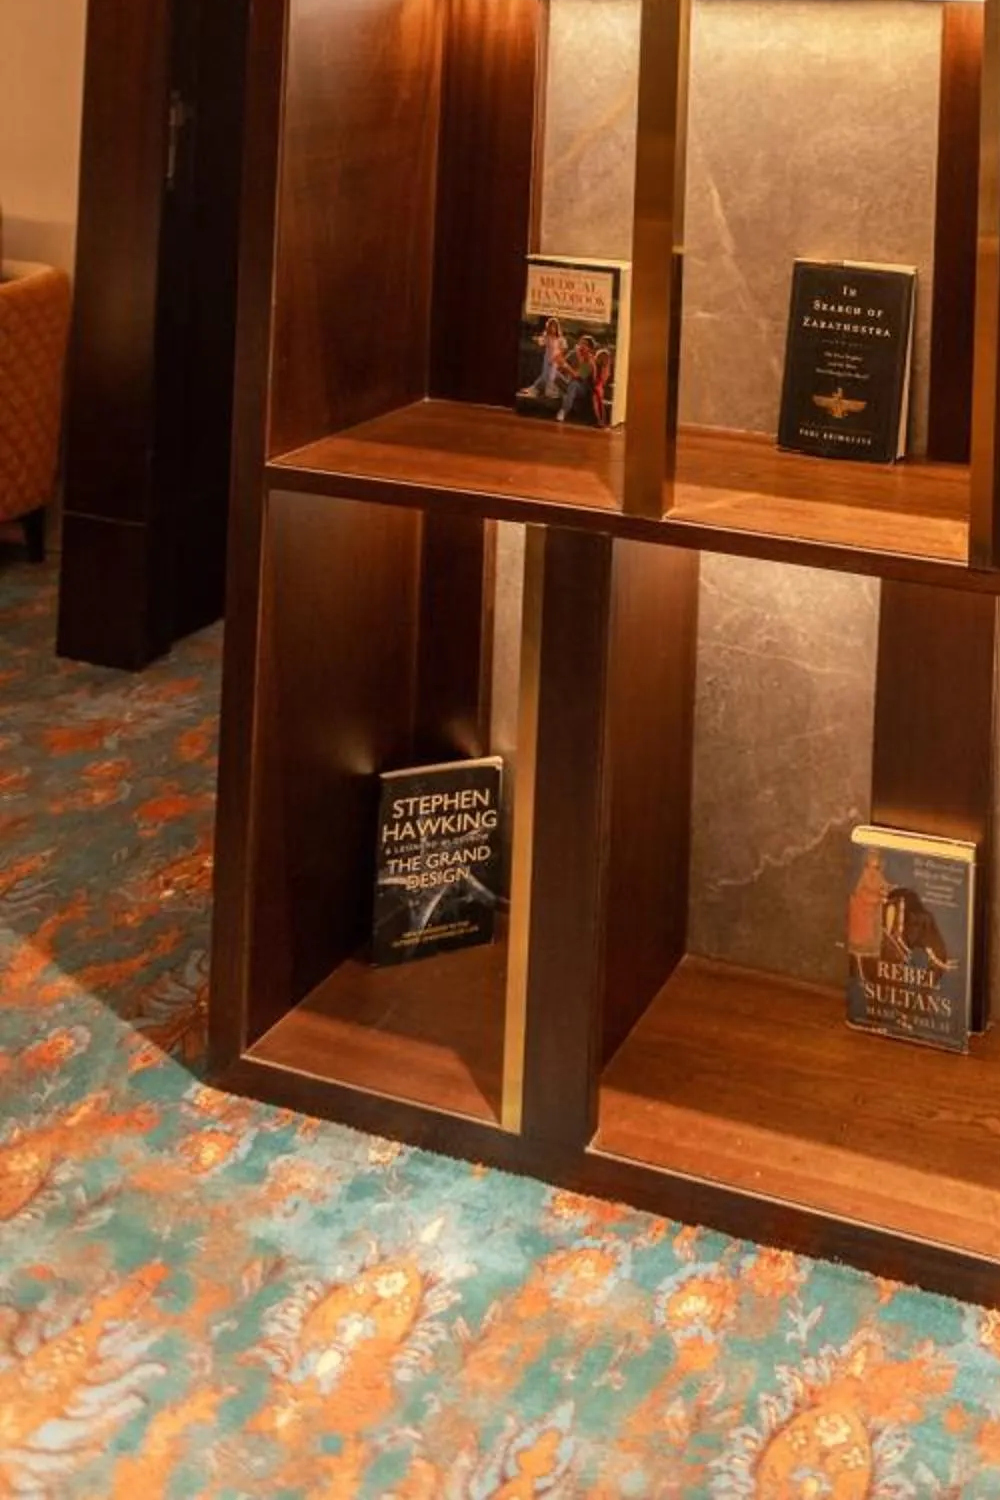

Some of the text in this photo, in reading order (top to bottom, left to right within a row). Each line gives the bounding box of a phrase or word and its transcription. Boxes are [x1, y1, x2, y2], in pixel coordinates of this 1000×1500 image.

[392, 788, 490, 819] STEPHEN
[382, 810, 498, 843] HAWKING
[387, 845, 491, 875] THE GRAND
[406, 867, 471, 889] DESIGN
[877, 961, 941, 990] REBEL
[864, 982, 953, 1016] SULTANS
